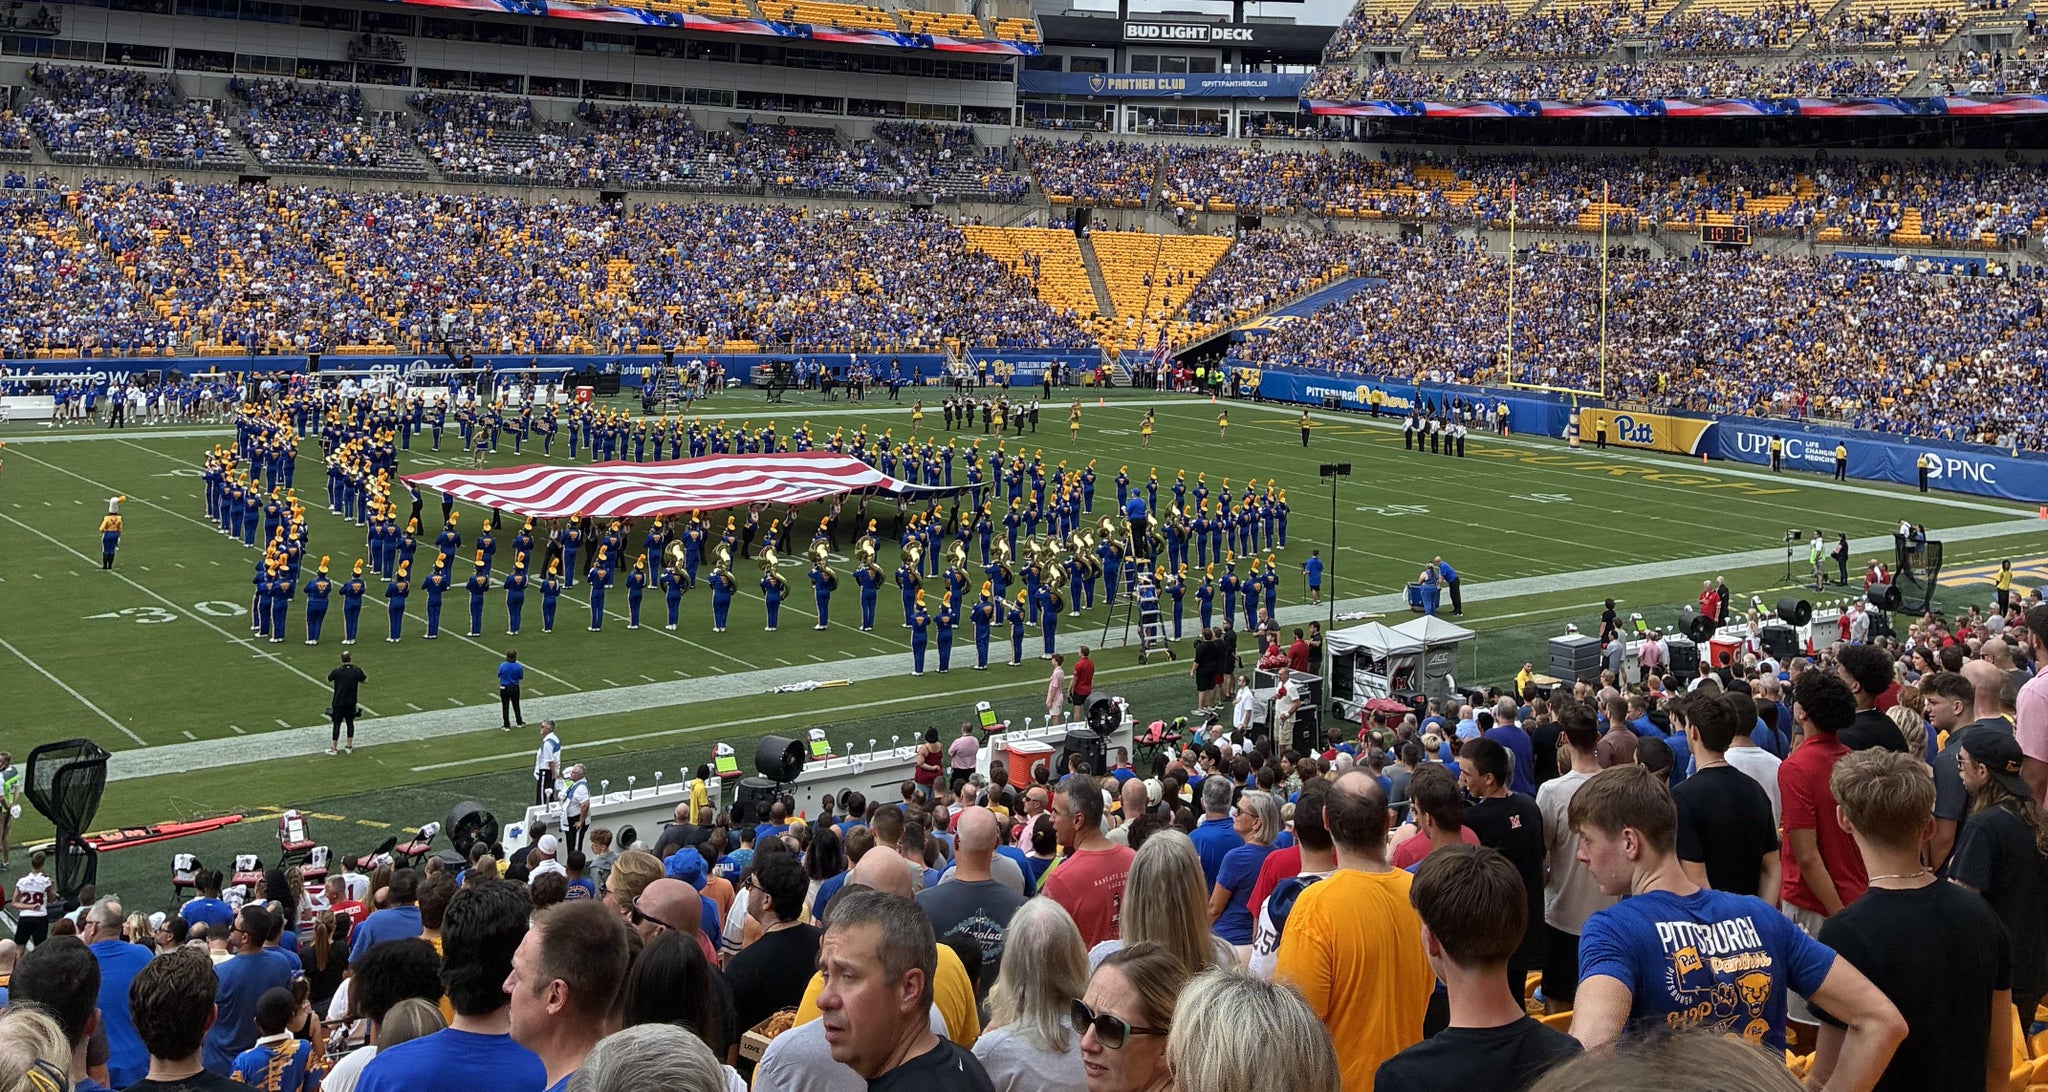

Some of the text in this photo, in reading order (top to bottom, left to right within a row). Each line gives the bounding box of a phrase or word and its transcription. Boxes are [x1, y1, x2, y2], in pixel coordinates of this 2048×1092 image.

[1127, 25, 1254, 40] BUD LIGHT DECK
[1108, 78, 1186, 90] PANTHER CLUB
[1202, 80, 1268, 88] @PITTPANTHERCLUB
[1613, 415, 1655, 444] Pitt
[1805, 447, 1836, 457] CHANGIN
[1945, 458, 1996, 484] PNC
[1428, 652, 1449, 664] ACC
[1655, 916, 1763, 955] PITTSBURGH
[1679, 953, 1698, 968] Pitt
[1710, 952, 1772, 975] Panthers
